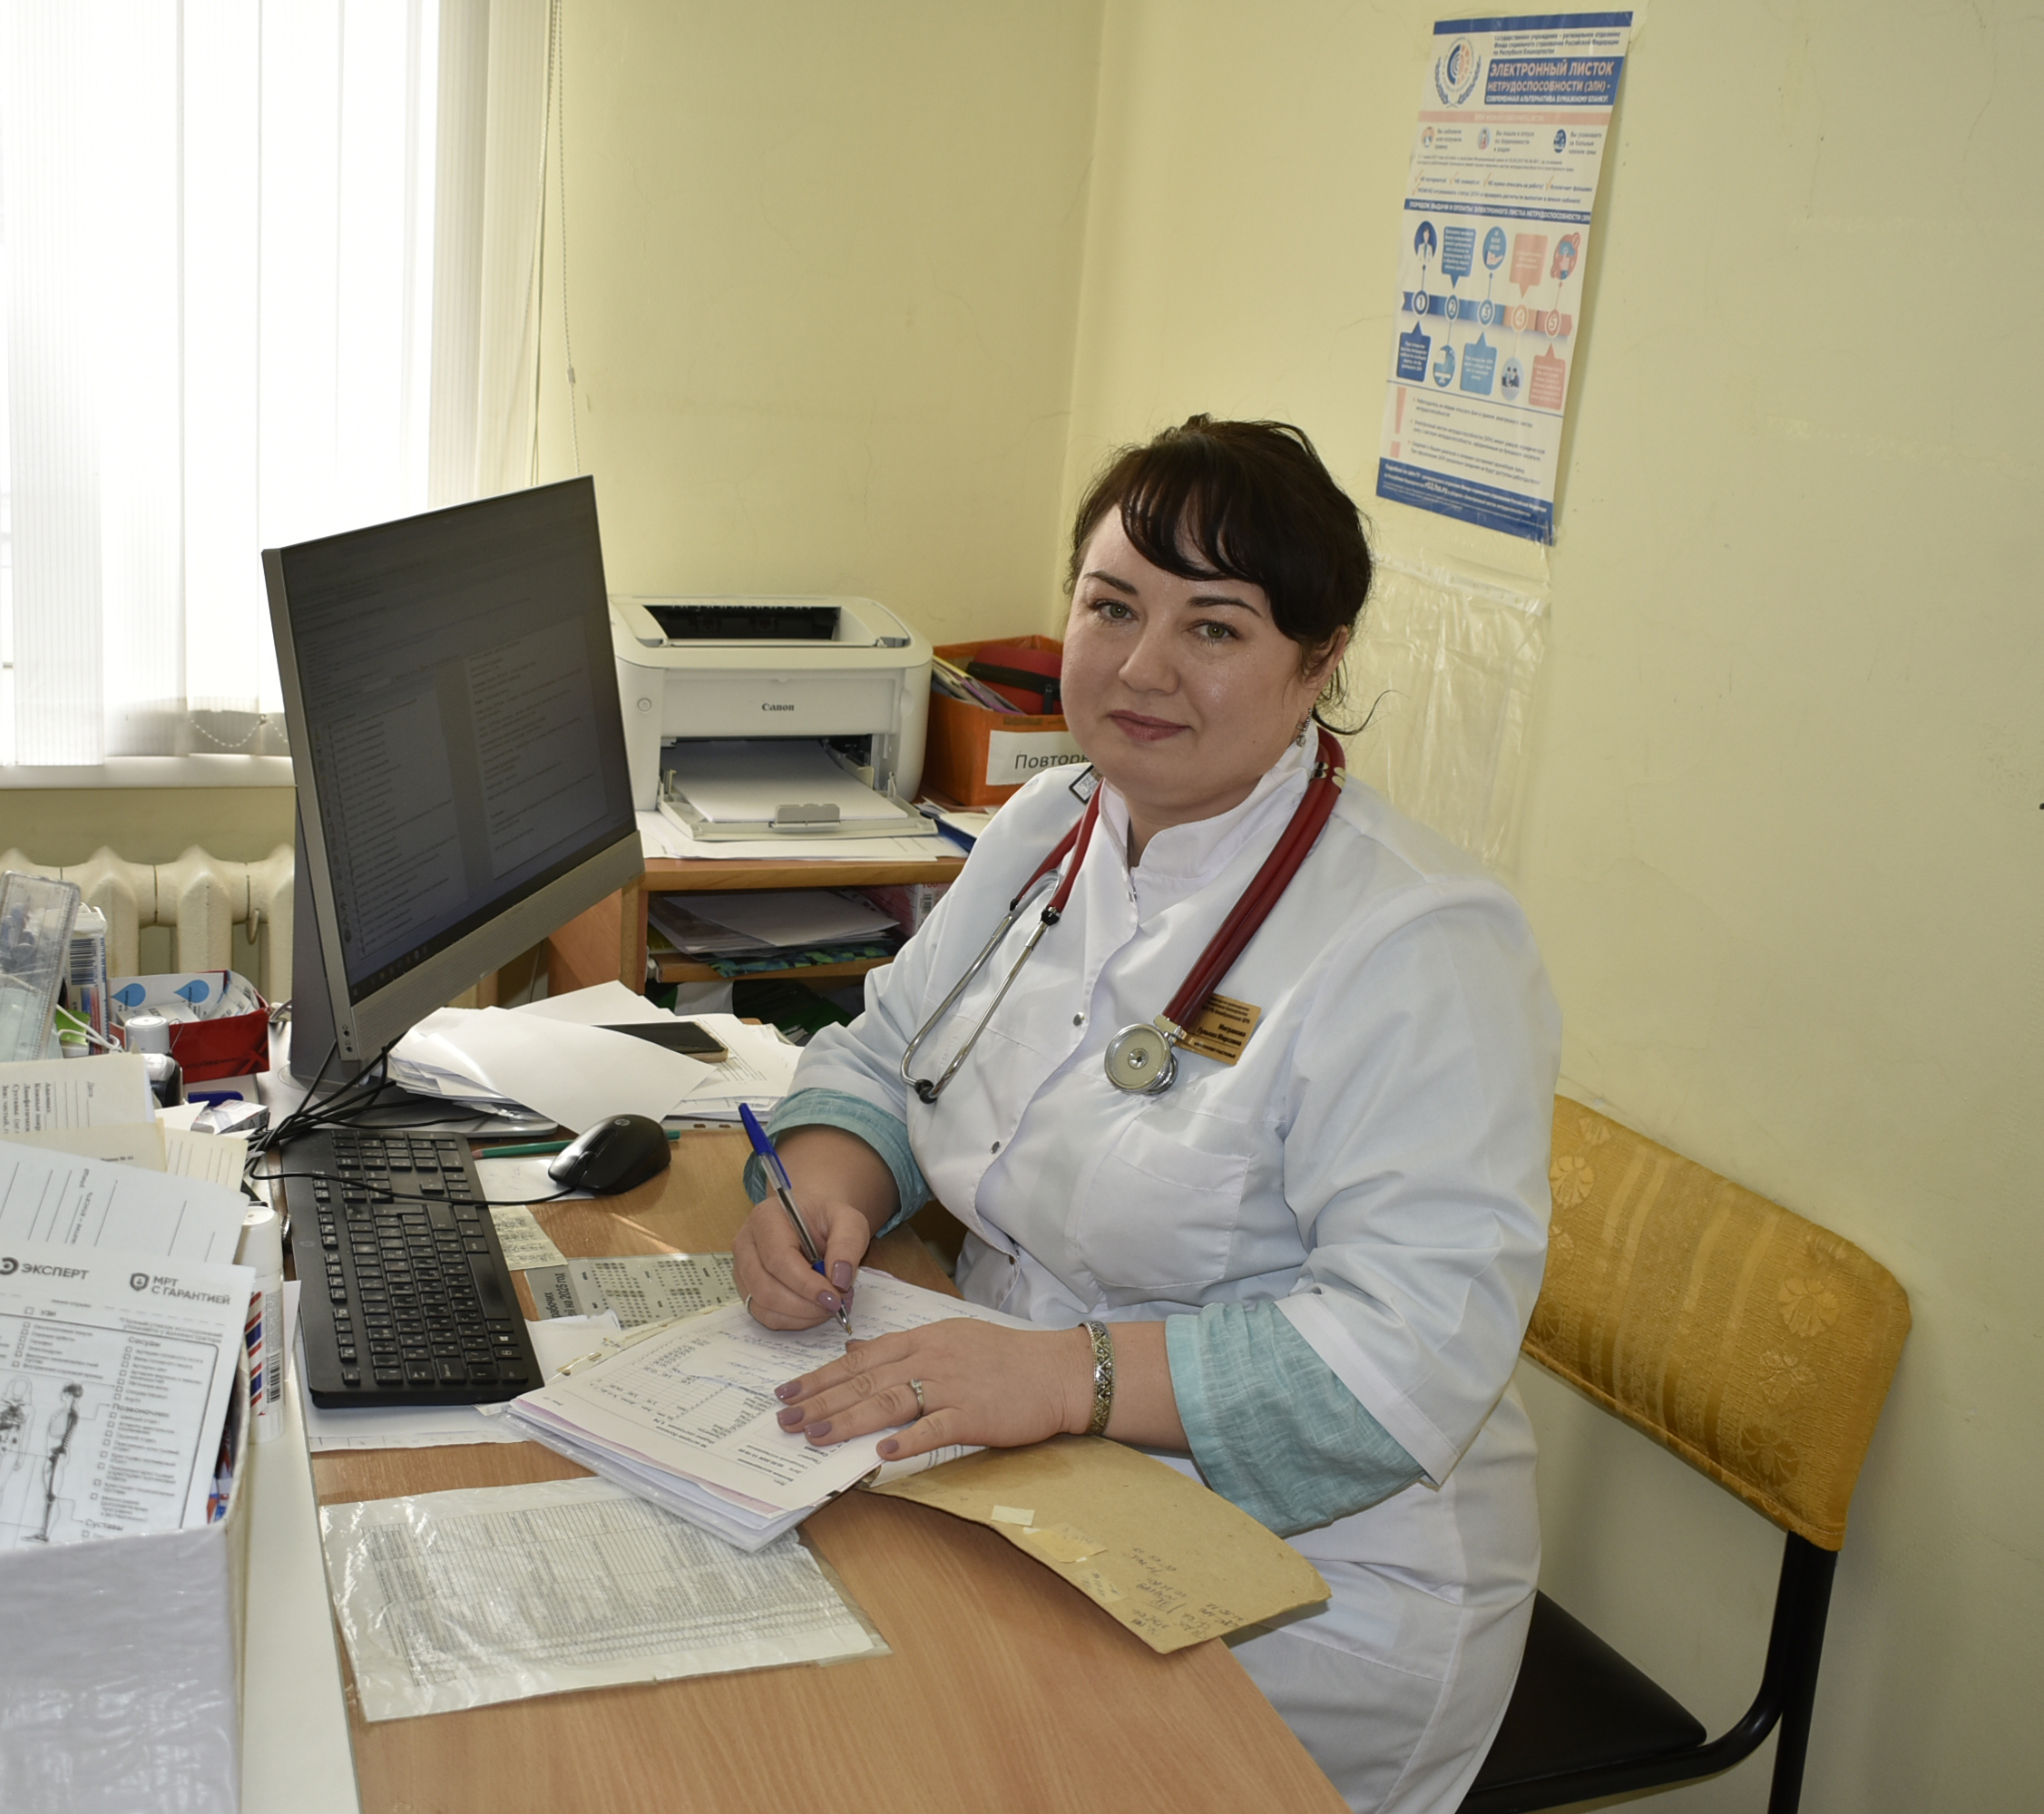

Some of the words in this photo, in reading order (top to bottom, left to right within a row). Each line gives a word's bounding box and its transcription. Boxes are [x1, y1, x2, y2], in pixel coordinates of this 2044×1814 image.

[1490, 59, 1568, 76] ЭЛЕКТРОННЫЙ
[1569, 61, 1614, 76] ЛИСТОК
[1488, 81, 1584, 93] НЕТРУДОСПОСОБНОСТИ
[1585, 81, 1606, 92] (ЭЛН)
[1474, 205, 1508, 215] ЭЛЕКТРОННОГО
[1527, 210, 1580, 219] НЕТРУДОСПОСОБНОСТИ
[1418, 297, 1424, 309] 1
[1449, 302, 1455, 313] 2
[1482, 307, 1490, 318] 3
[1516, 310, 1524, 323] 4
[1549, 317, 1556, 329] 5
[761, 703, 795, 712] Canon
[79, 1168, 90, 1188] улица
[71, 1223, 83, 1245] житие
[81, 1192, 93, 1217] вписать
[21, 1263, 89, 1280] ЭКСПЕРТ
[555, 1272, 566, 1282] год
[153, 1275, 178, 1287] МРТ
[152, 1285, 160, 1294] С
[163, 1287, 230, 1304] ГАРАНТИЕЙ
[556, 1284, 571, 1298] 2025
[544, 1292, 561, 1317] рабочих
[175, 1325, 223, 1337] исследований
[128, 1336, 161, 1347] Сосуды
[113, 1403, 170, 1418] Позвоночник
[85, 1519, 124, 1531] Суставы
